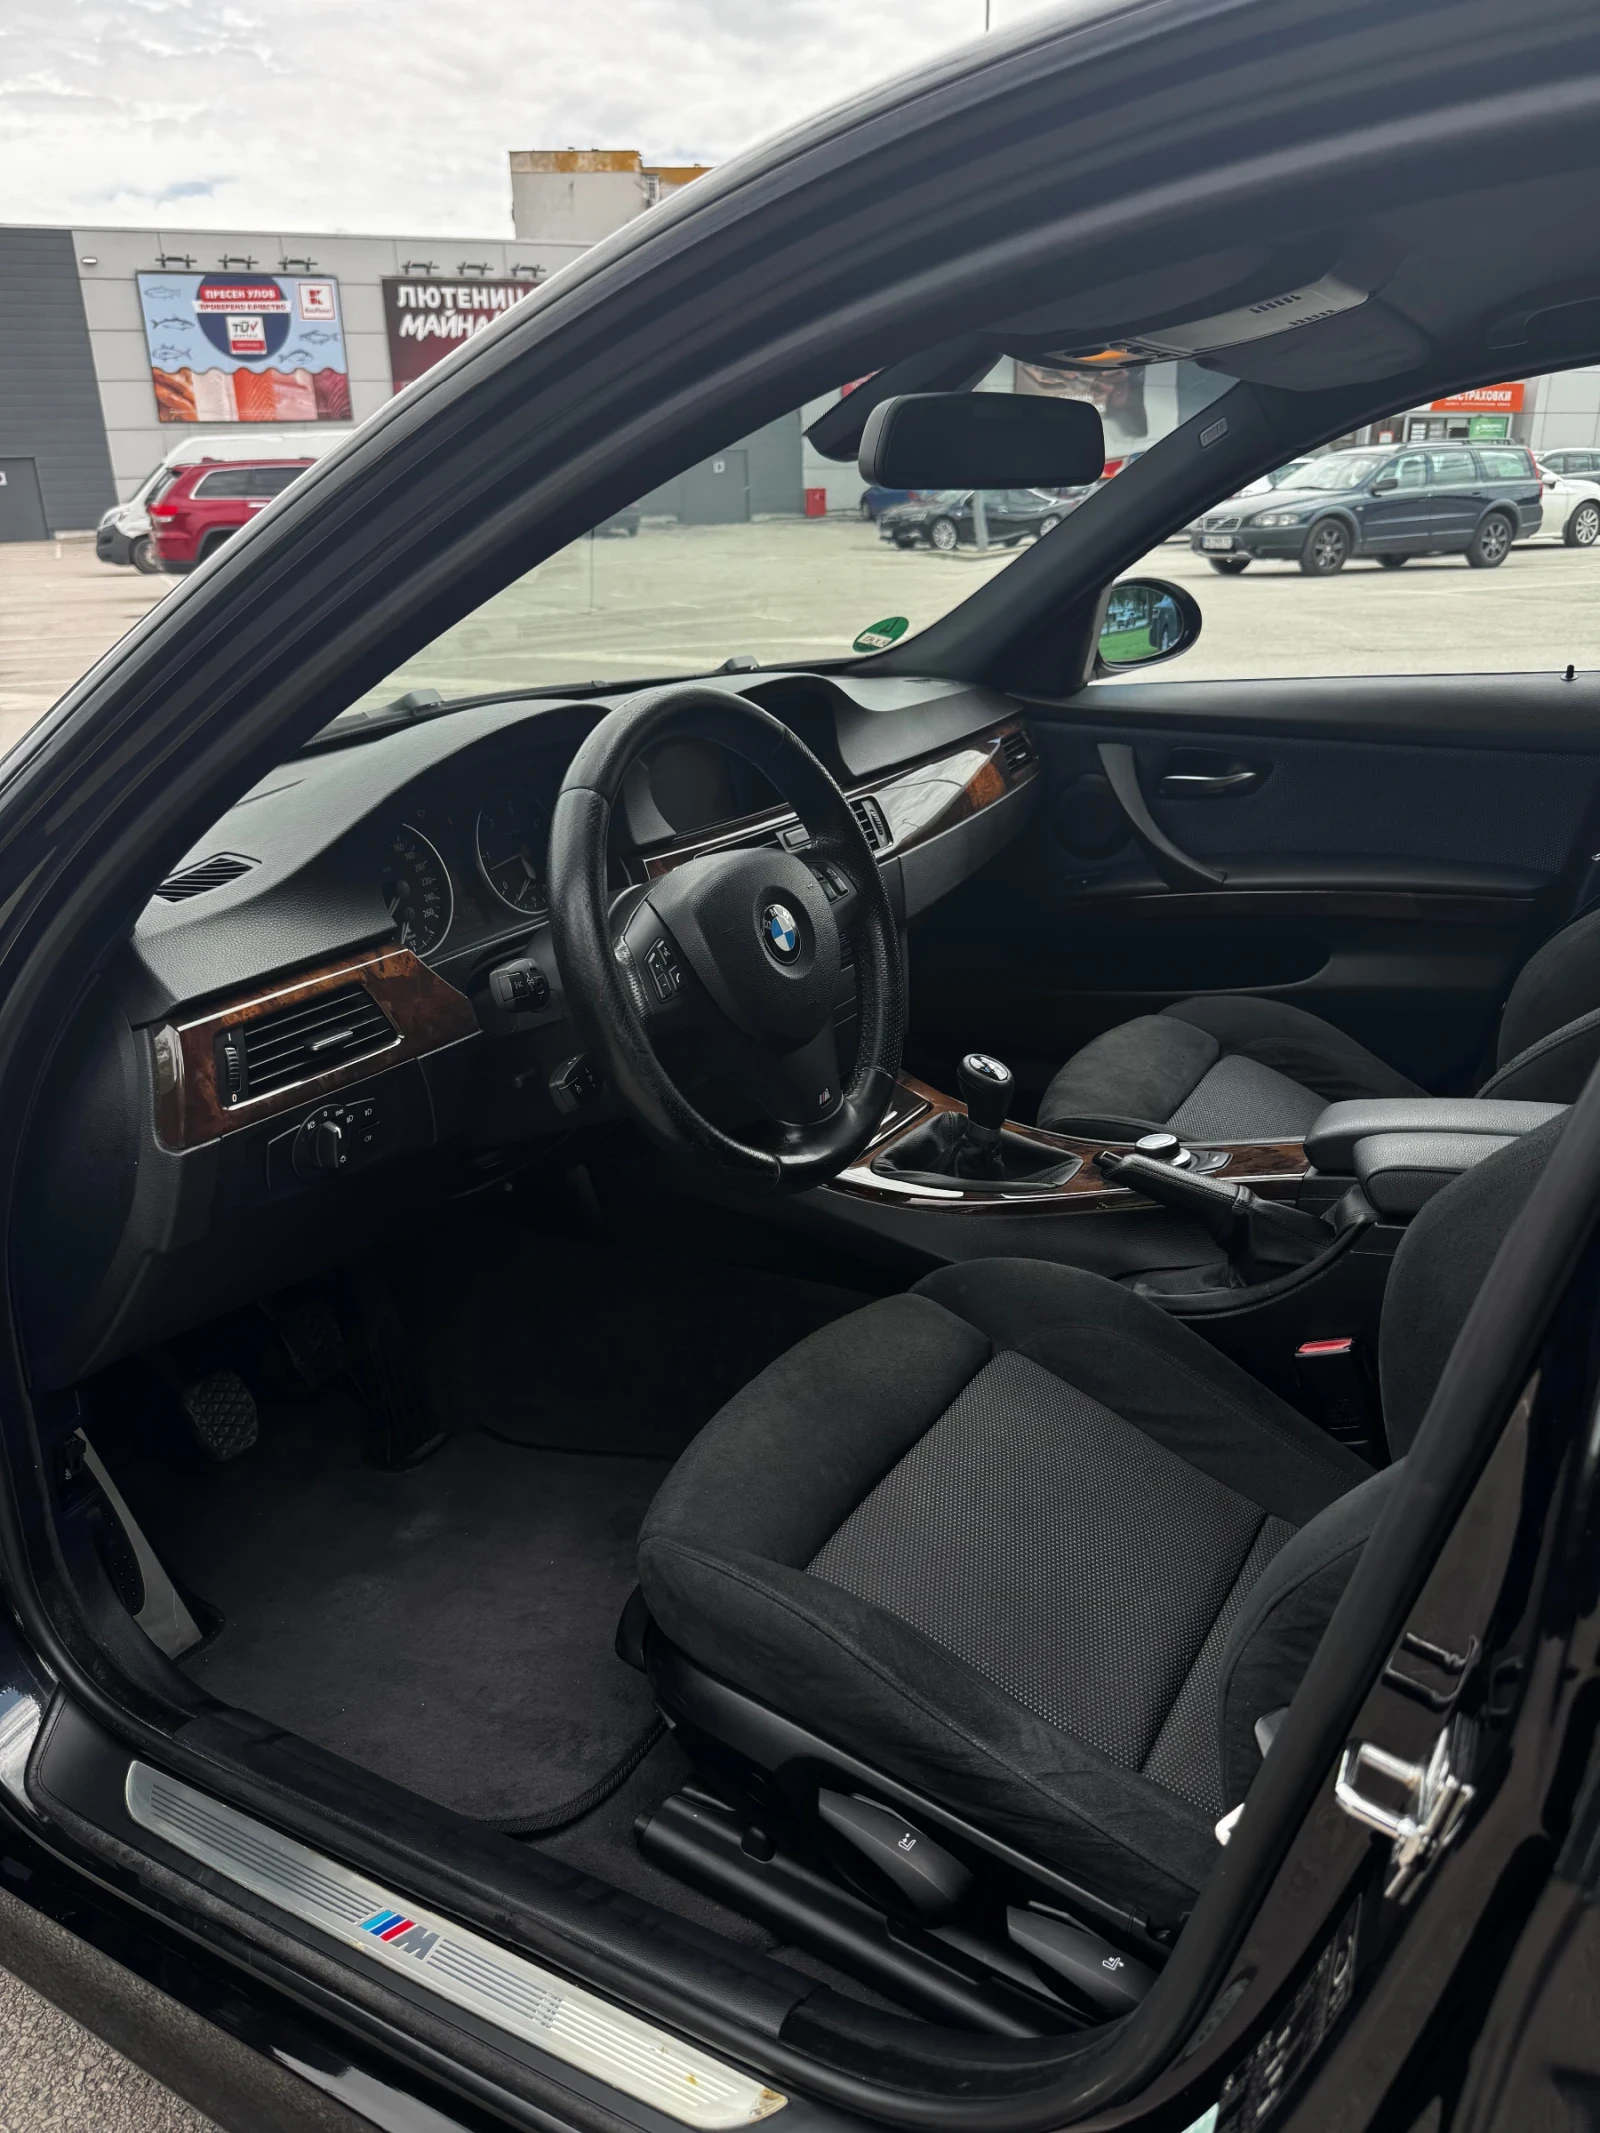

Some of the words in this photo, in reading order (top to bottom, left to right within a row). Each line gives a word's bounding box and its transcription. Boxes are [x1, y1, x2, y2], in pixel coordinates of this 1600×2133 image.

[204, 289, 246, 300] ПРЕСЕН
[247, 289, 277, 299] УЛОВ
[397, 285, 534, 309] ЛЮТЕНИЦ
[232, 321, 259, 333] TÜV
[420, 876, 433, 887] 220
[423, 892, 436, 902] 240
[422, 908, 435, 918] 260
